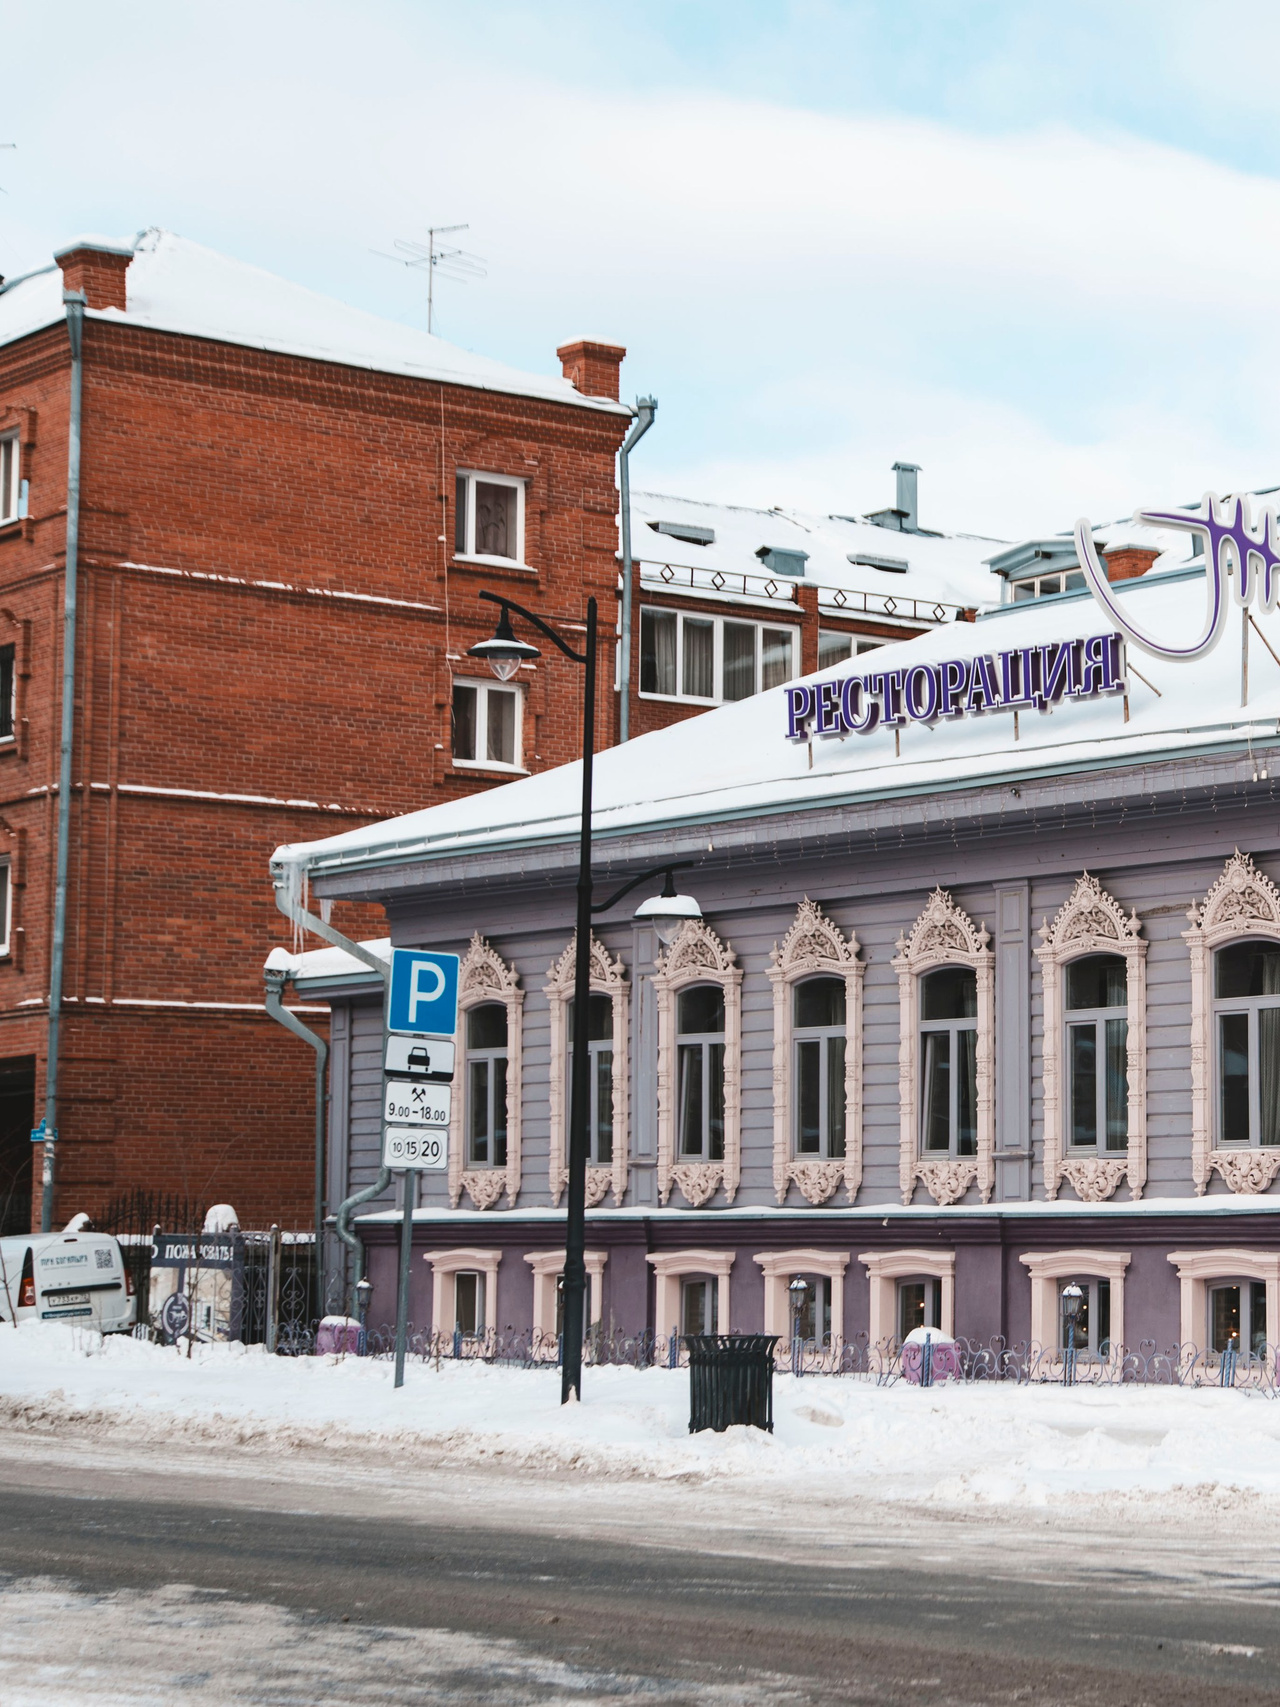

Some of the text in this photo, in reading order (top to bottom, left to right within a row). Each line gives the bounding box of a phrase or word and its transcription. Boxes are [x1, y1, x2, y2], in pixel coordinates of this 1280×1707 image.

[783, 631, 1127, 741] РЕСТОРАЦИЯ
[408, 960, 446, 1024] P
[392, 1140, 440, 1157] 10 15 20
